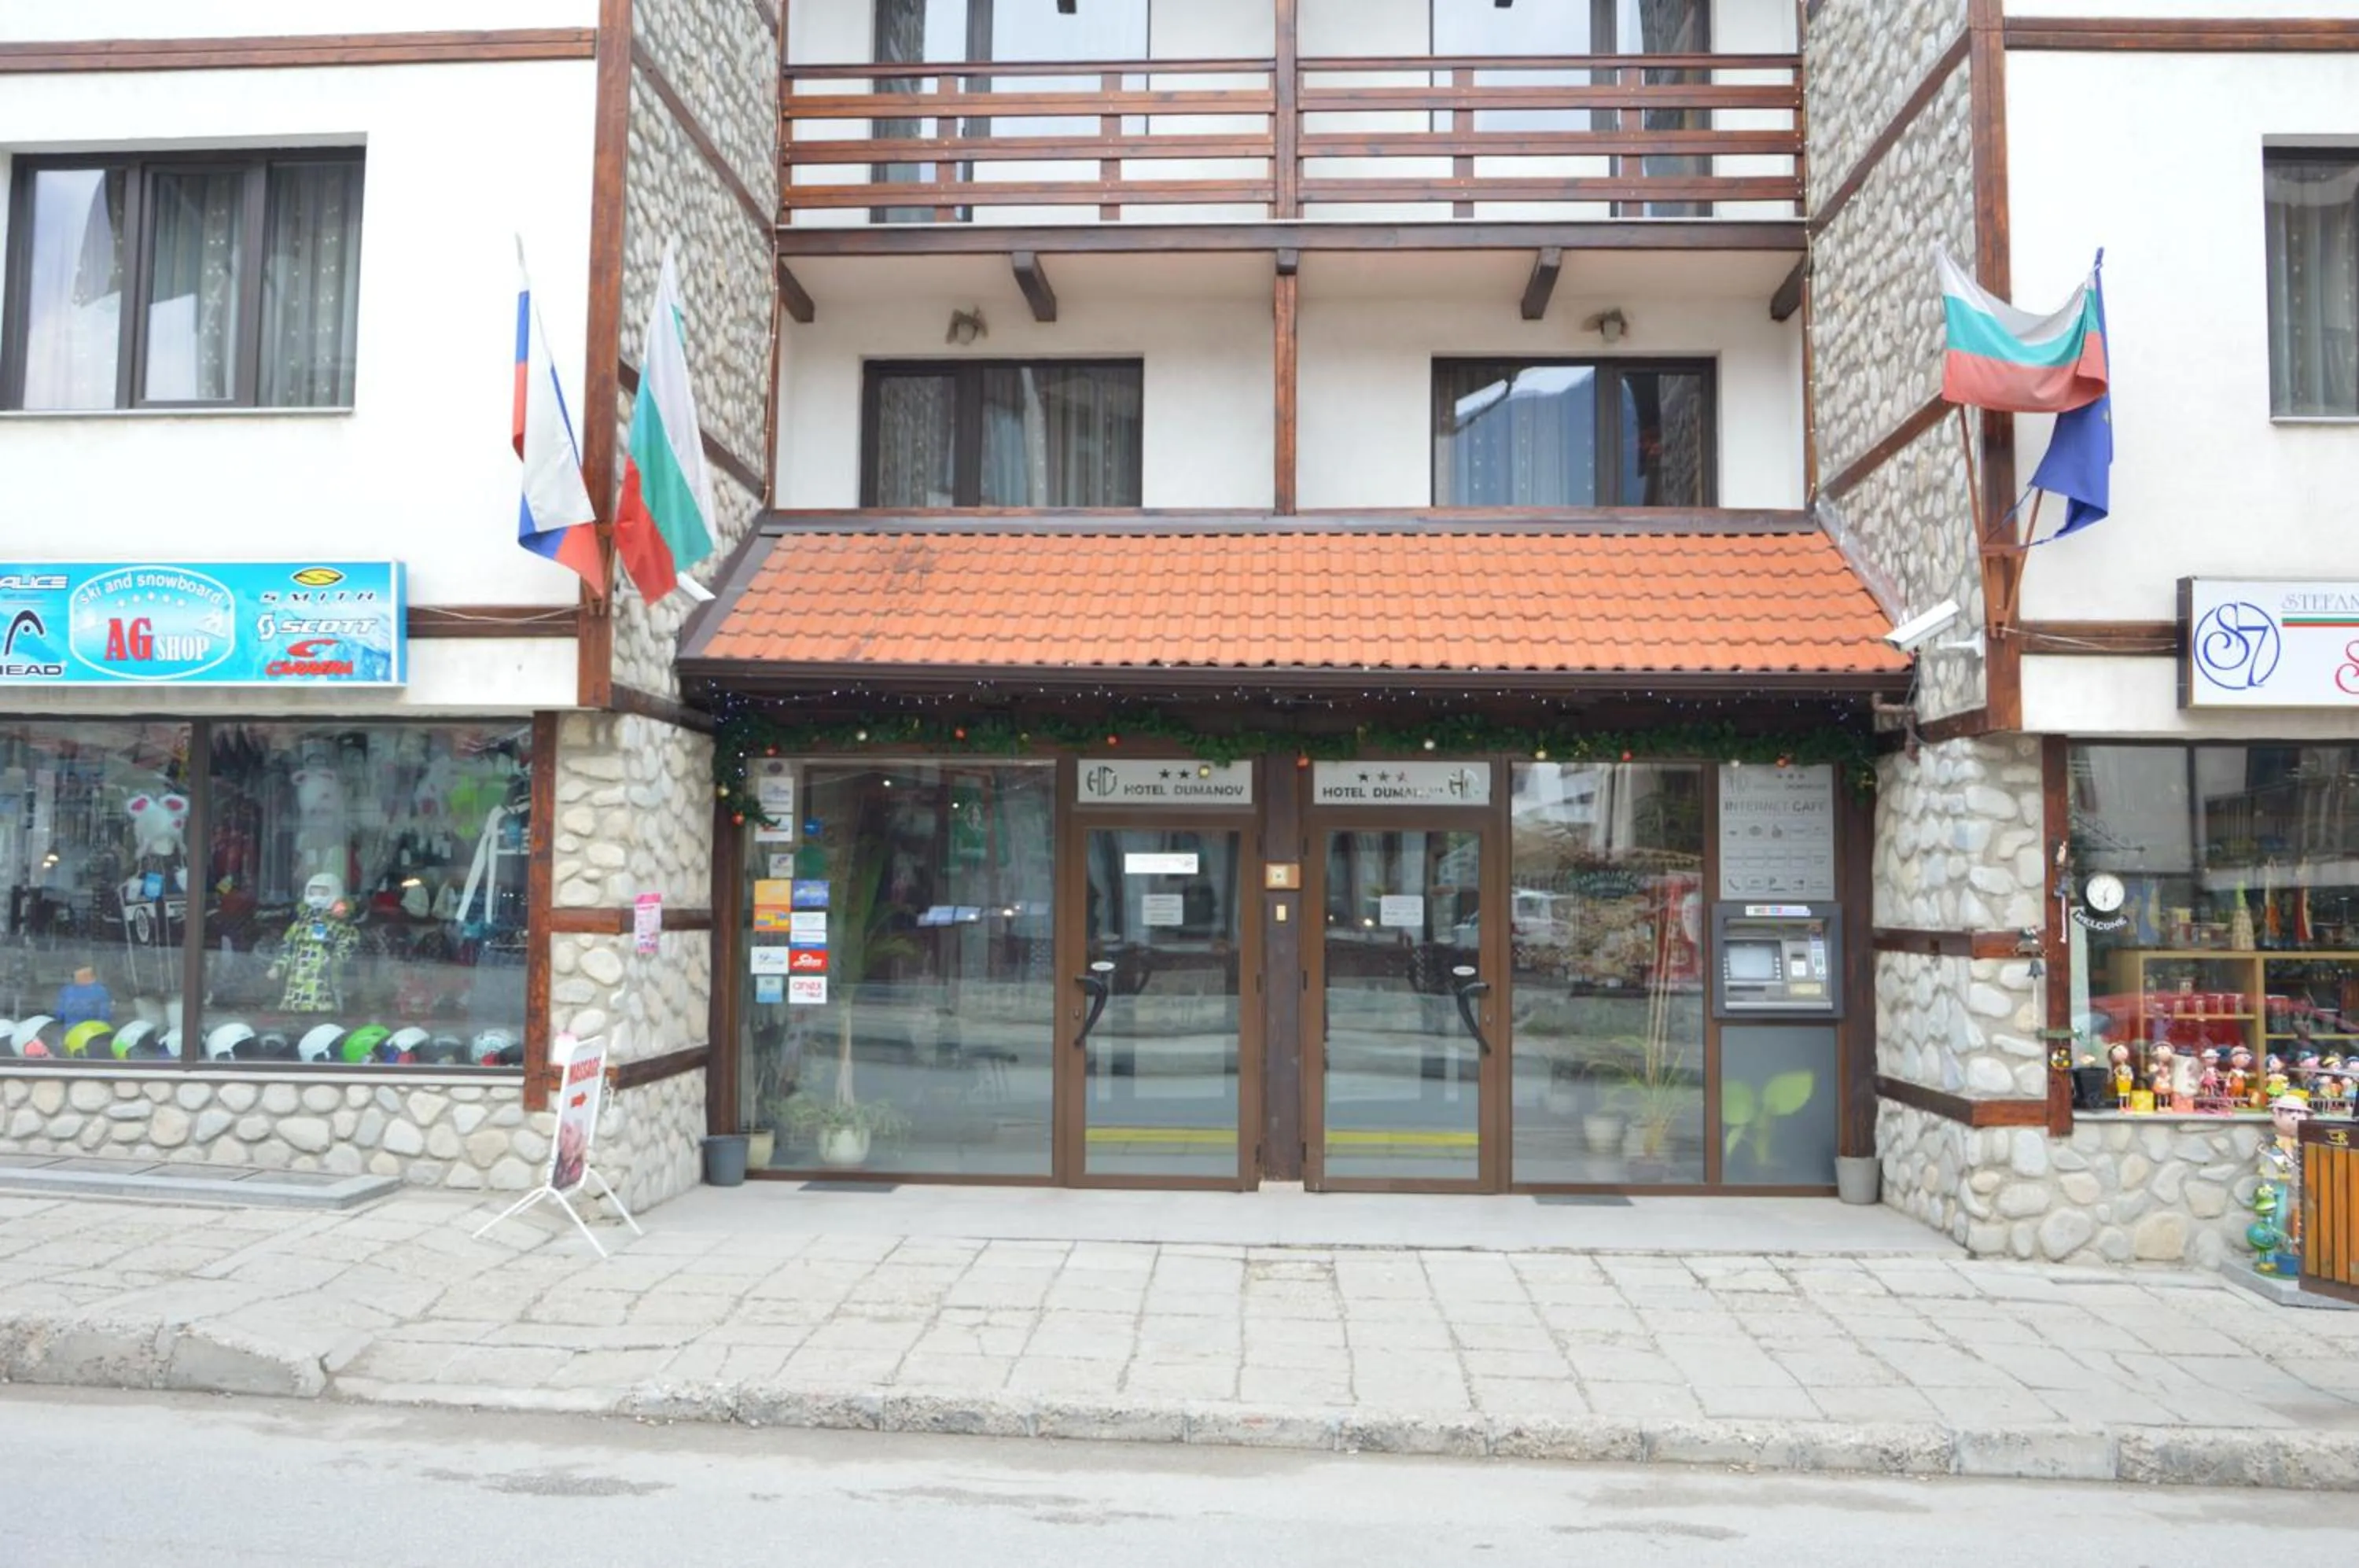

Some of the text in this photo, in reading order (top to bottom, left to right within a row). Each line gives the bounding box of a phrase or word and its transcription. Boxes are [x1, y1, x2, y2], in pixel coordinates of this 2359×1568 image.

[79, 572, 225, 604] ski and snowboard
[262, 591, 375, 602] SMITH
[276, 618, 378, 634] SCOTT
[104, 617, 210, 661] AG SHOP
[1124, 785, 1244, 796] HOTEL DUMANOV
[1323, 787, 1366, 798] HOTEL
